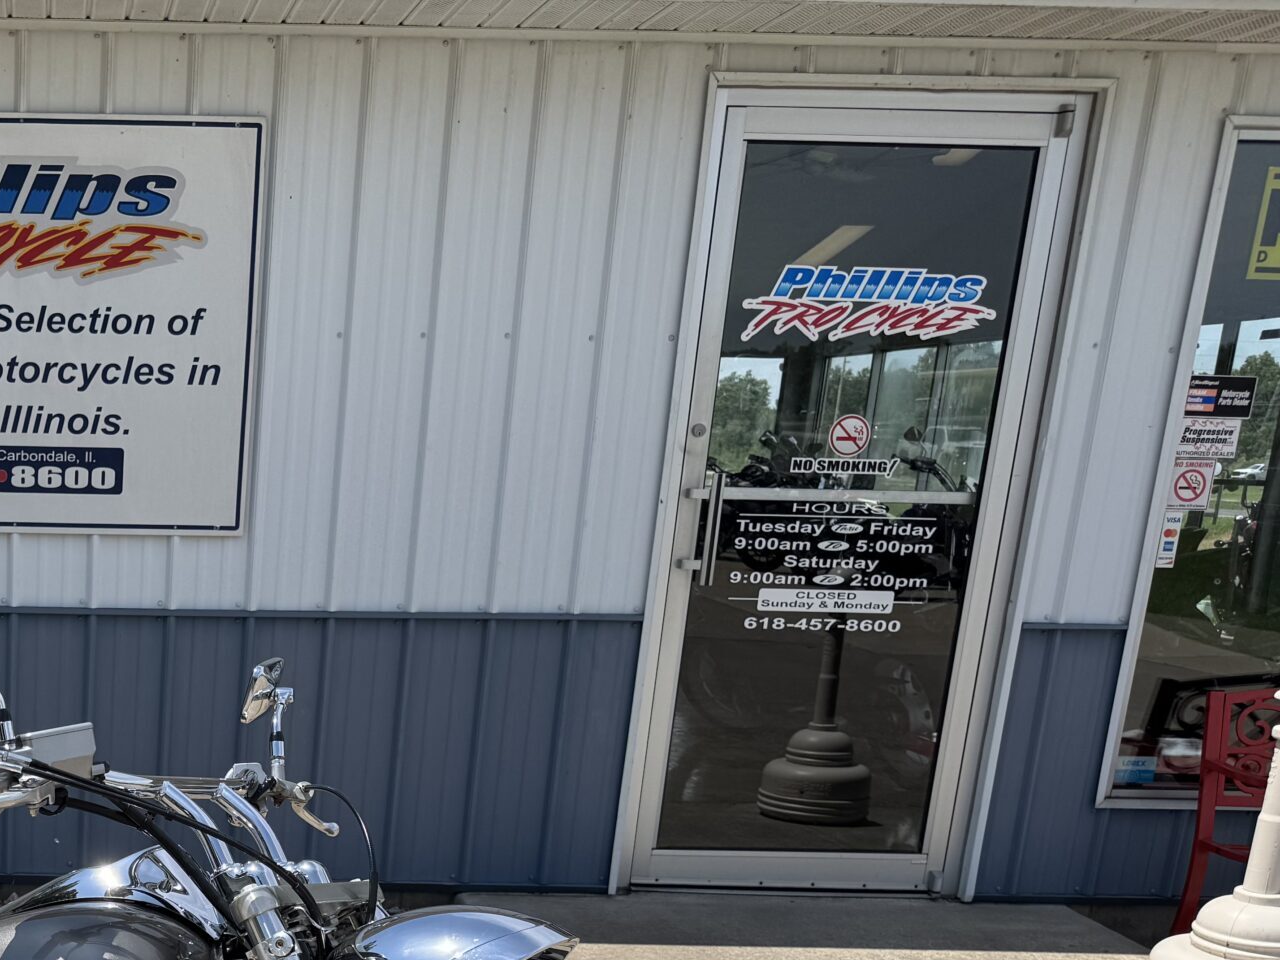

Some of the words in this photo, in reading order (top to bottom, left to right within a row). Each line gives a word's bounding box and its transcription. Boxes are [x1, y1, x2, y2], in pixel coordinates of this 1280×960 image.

[772, 266, 985, 304] Phillips
[166, 308, 205, 336] of
[744, 298, 851, 341] PRO
[829, 299, 996, 340] CYCLE
[187, 357, 222, 386] in
[1221, 389, 1250, 400] Motorcycle
[1232, 398, 1250, 406] Dealer
[0, 404, 131, 436] Illinois.
[1180, 435, 1228, 445] Suspension
[1183, 427, 1234, 437] Progressive
[791, 458, 815, 473] NO
[815, 458, 900, 478] SMOKING!
[792, 502, 889, 515] HOURS
[736, 519, 826, 536] Tuesday
[870, 522, 937, 539] Friday
[734, 537, 811, 551] 9:00am
[822, 541, 845, 550] To
[856, 540, 933, 556] 5:00pm
[783, 555, 880, 572] Saturday
[729, 571, 806, 585] 9:00am
[817, 576, 840, 584] To
[849, 574, 928, 590] 2:00pm
[795, 591, 857, 601] CLOSED
[760, 600, 815, 610] Sunday
[818, 601, 829, 609] &
[838, 601, 889, 611] Monday
[743, 617, 901, 633] 618-457-8600
